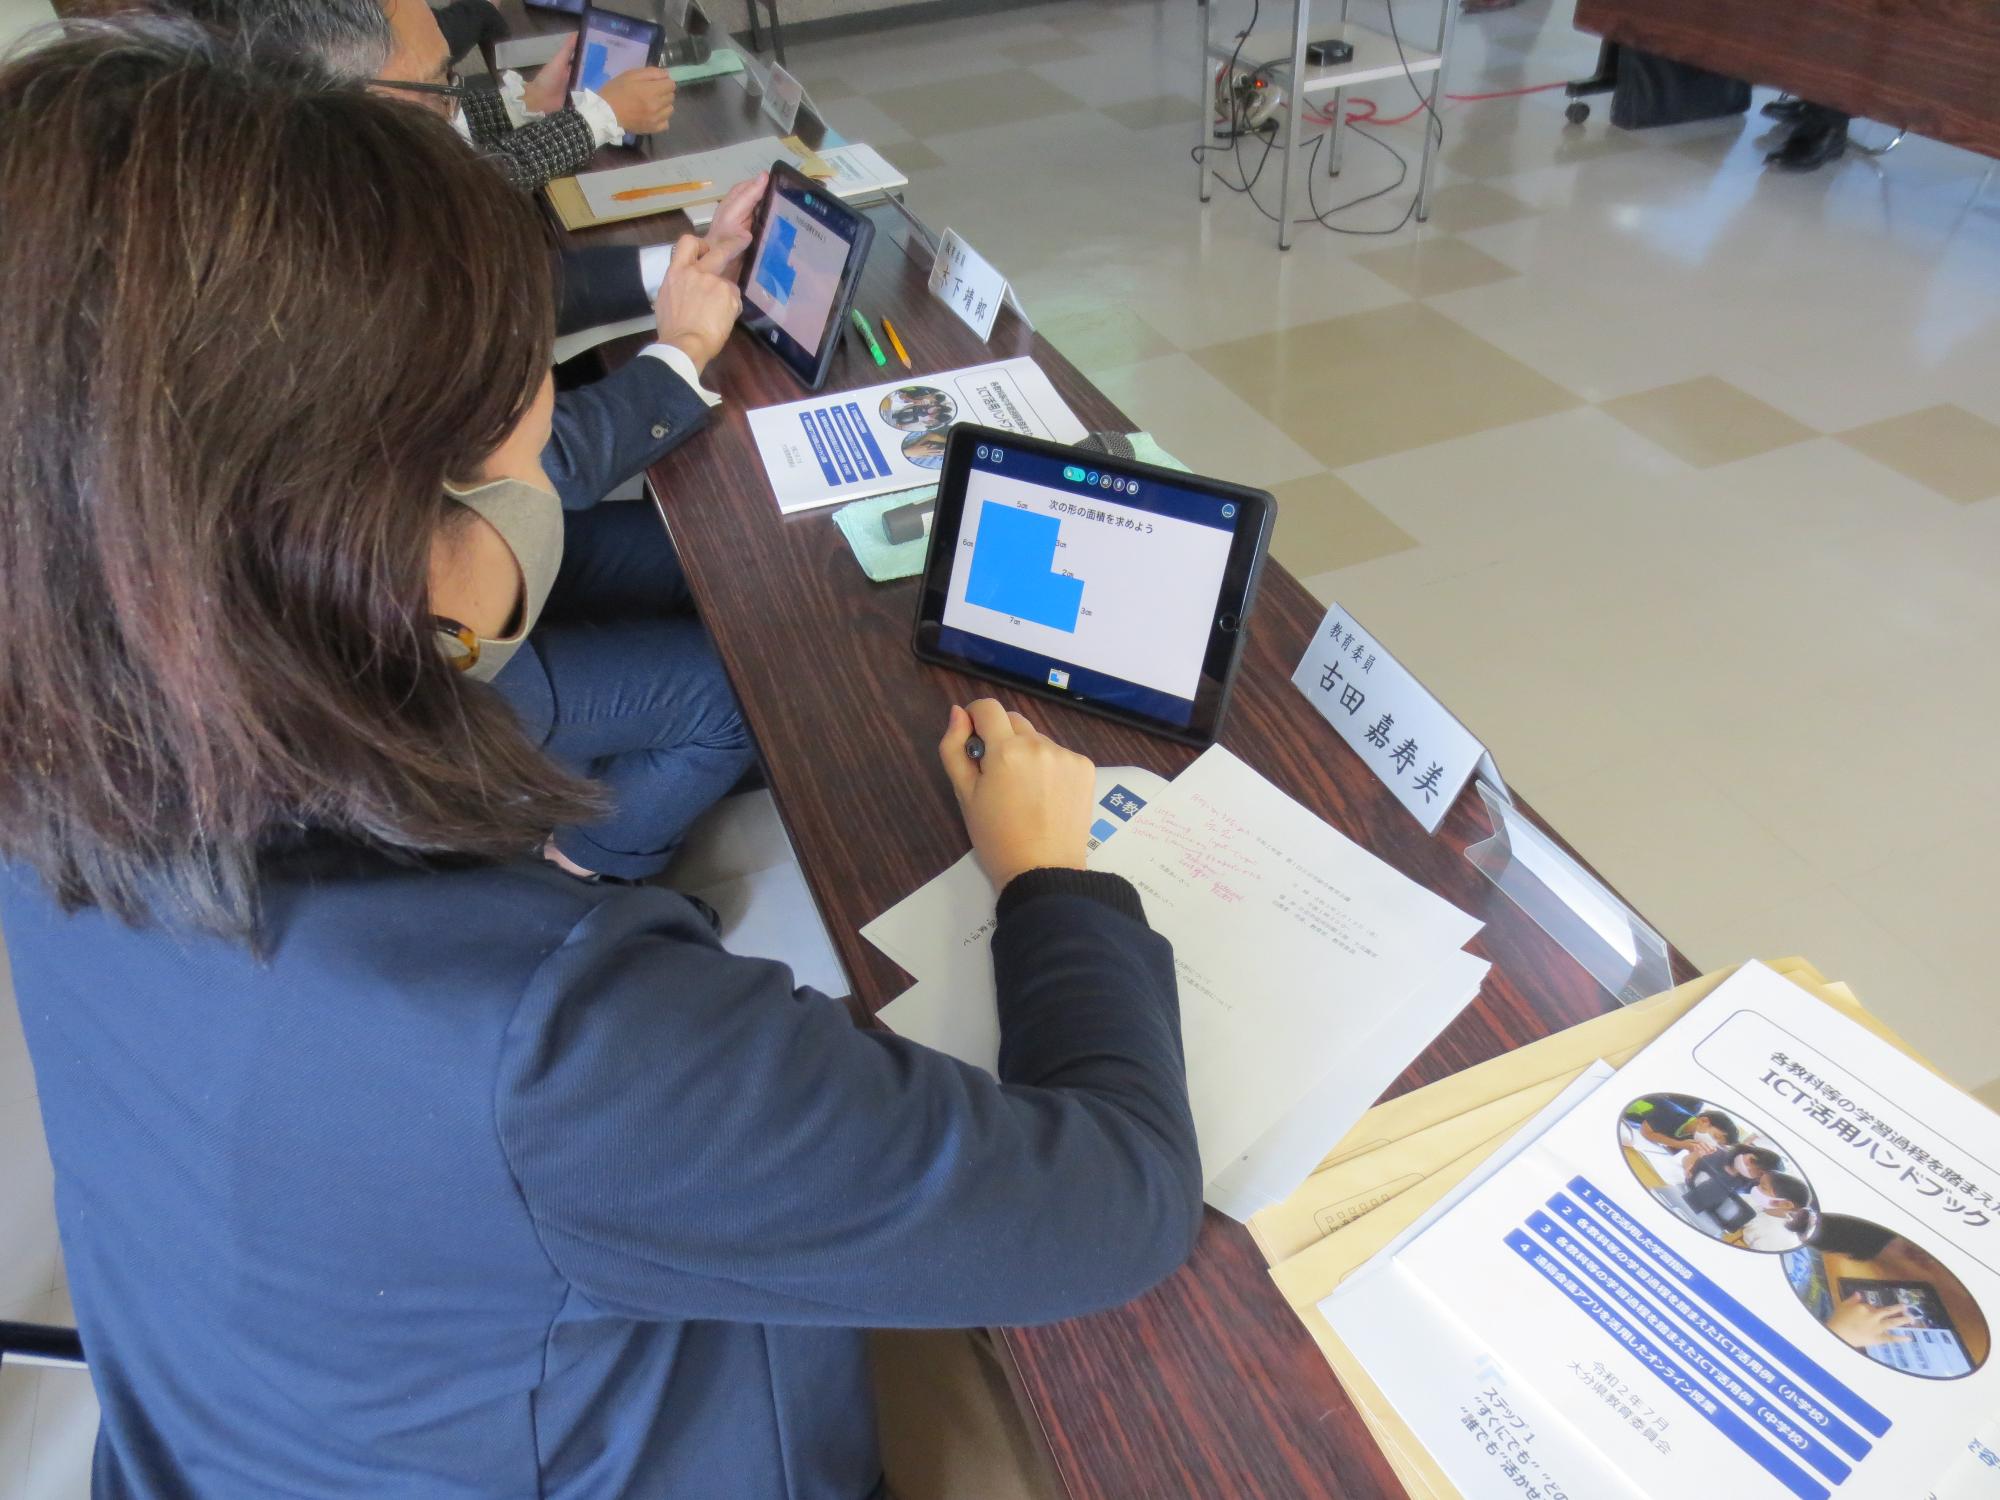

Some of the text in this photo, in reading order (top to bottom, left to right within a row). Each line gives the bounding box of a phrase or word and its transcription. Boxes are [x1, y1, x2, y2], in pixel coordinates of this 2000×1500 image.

[1048, 499, 1153, 534] 次の形の面積を求めよう
[1329, 621, 1376, 675] 教育委員
[1319, 660, 1365, 716] 古田
[1759, 1068, 1990, 1227] ICT活用ハンドブック
[1540, 1223, 1552, 1234] 3
[1561, 1205, 1573, 1216] 2
[1519, 1243, 1531, 1252] 4
[1567, 1360, 1673, 1456] 大分県教育委員会
